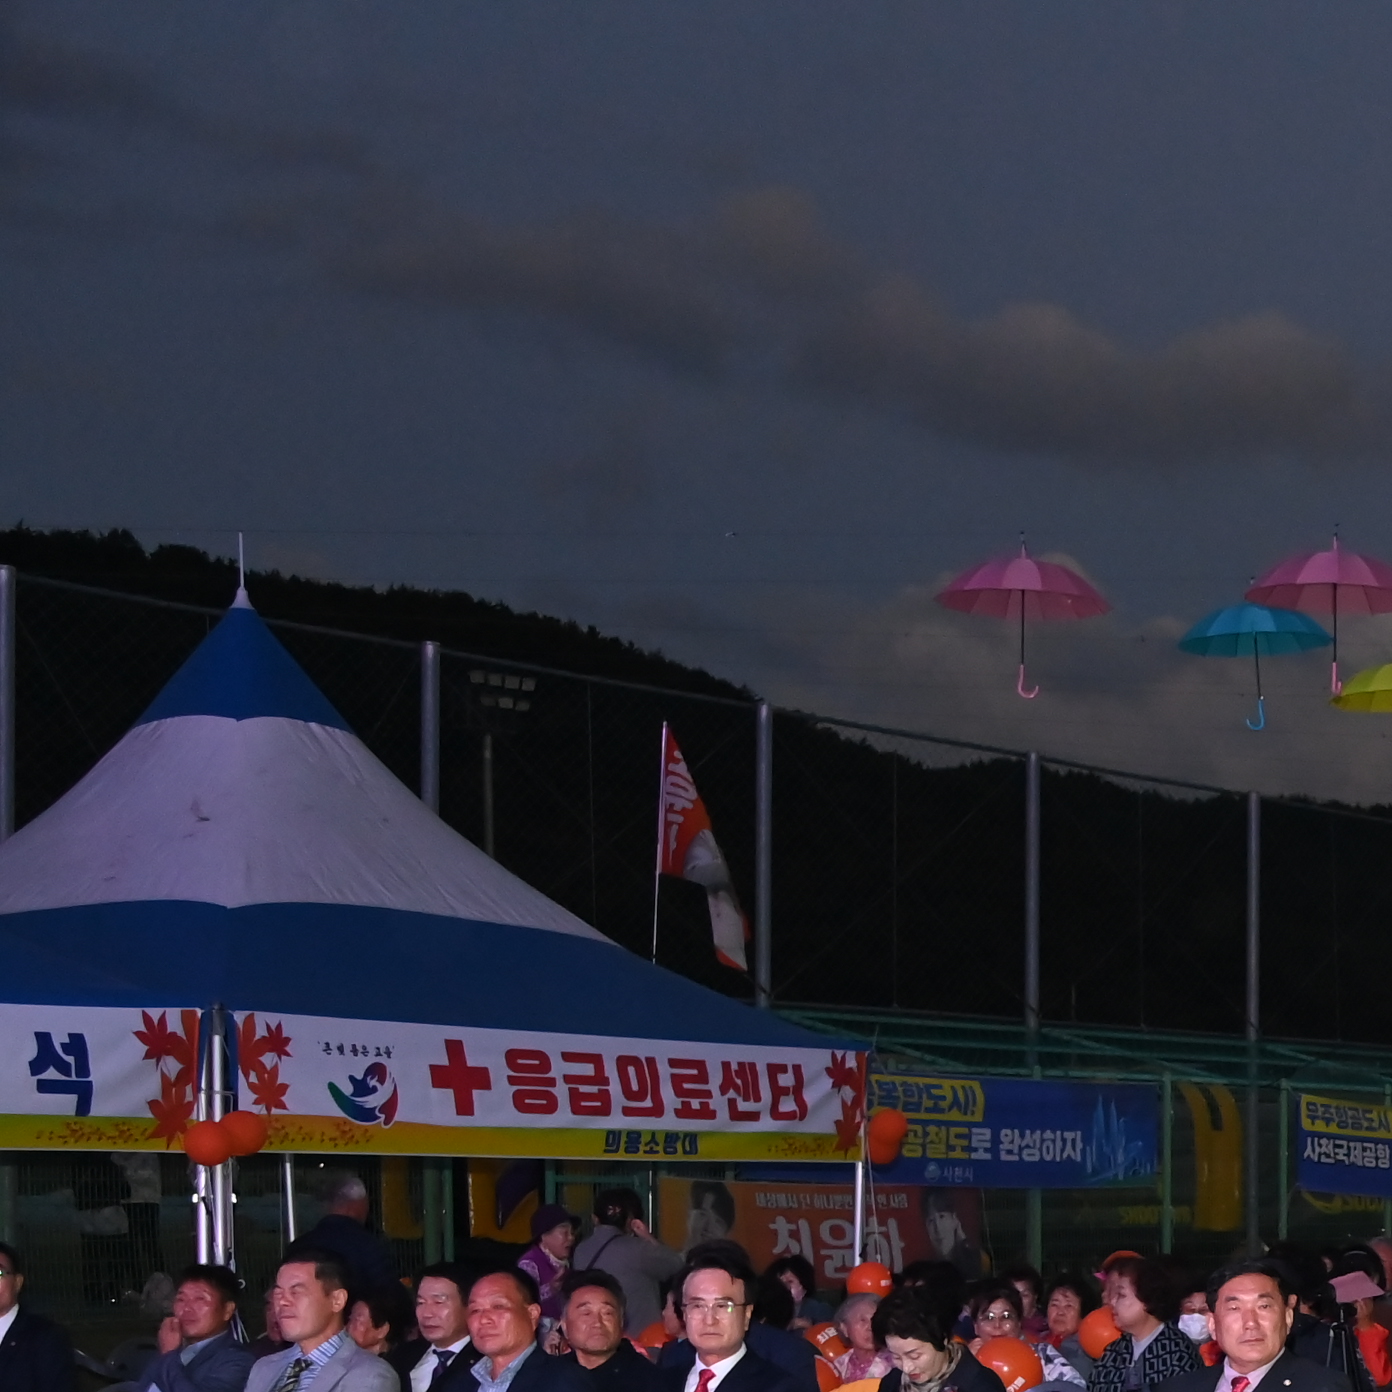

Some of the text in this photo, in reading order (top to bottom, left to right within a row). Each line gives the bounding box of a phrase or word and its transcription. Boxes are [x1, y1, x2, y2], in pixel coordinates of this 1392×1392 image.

[28, 1031, 93, 1117] 석
[504, 1048, 808, 1122] 응급의료센터
[1305, 1101, 1390, 1133] 우주항공도시
[603, 1130, 699, 1156] 의용소방대
[999, 1127, 1083, 1162] 완성하자
[1303, 1136, 1390, 1169] 사천국제공항
